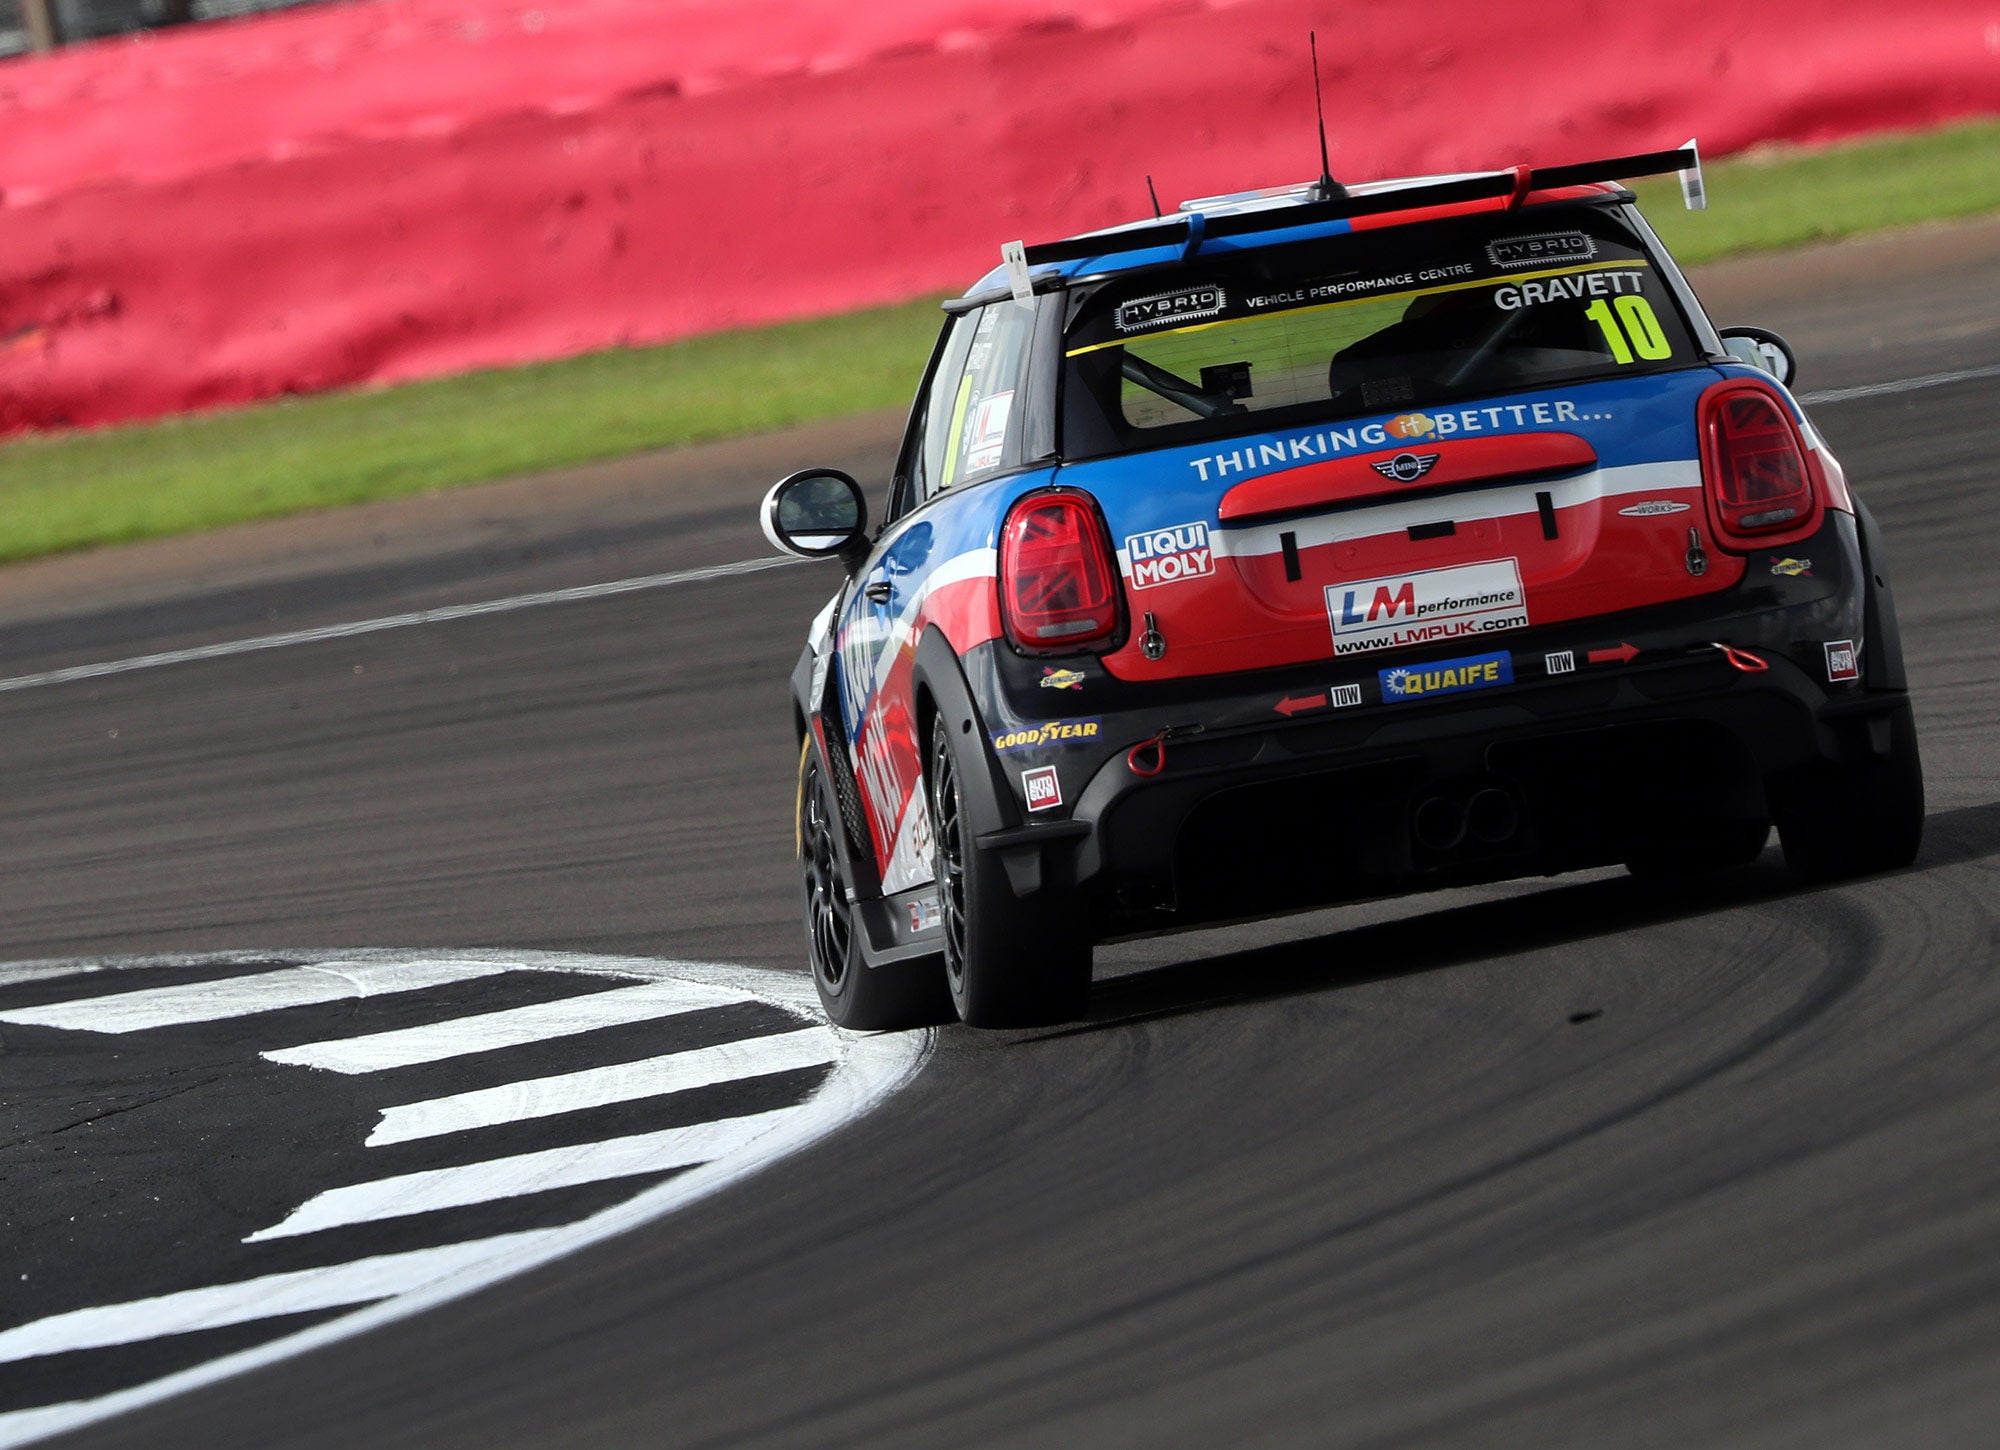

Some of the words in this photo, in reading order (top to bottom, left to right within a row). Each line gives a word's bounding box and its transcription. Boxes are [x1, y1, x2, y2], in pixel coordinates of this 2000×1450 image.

[1495, 238, 1584, 256] HYBRID
[1246, 290, 1304, 308] VEHICLE
[1310, 273, 1414, 299] PERFORMANCE
[1419, 263, 1474, 281] CENTRE
[1494, 272, 1643, 310] GRAVETT
[1125, 293, 1214, 318] HYBRID
[1584, 295, 1672, 364] 10
[1189, 424, 1386, 482] THINKING
[1400, 417, 1419, 434] it
[1434, 400, 1612, 435] BETTER...
[1396, 462, 1417, 472] MINI
[1638, 504, 1672, 514] WORKS
[1131, 525, 1206, 560] LIQUI
[1135, 550, 1210, 585] MOLY
[1341, 583, 1415, 626] LM
[1417, 590, 1514, 617] performance
[1336, 615, 1527, 653] www.LMPUK.com
[1549, 652, 1573, 673] TOW
[1041, 672, 1085, 688] SUNOCO
[1405, 661, 1500, 694] QUAIFE
[1334, 686, 1360, 706] TOW
[1028, 775, 1053, 790] AUTO
[1030, 785, 1056, 802] GLYM
